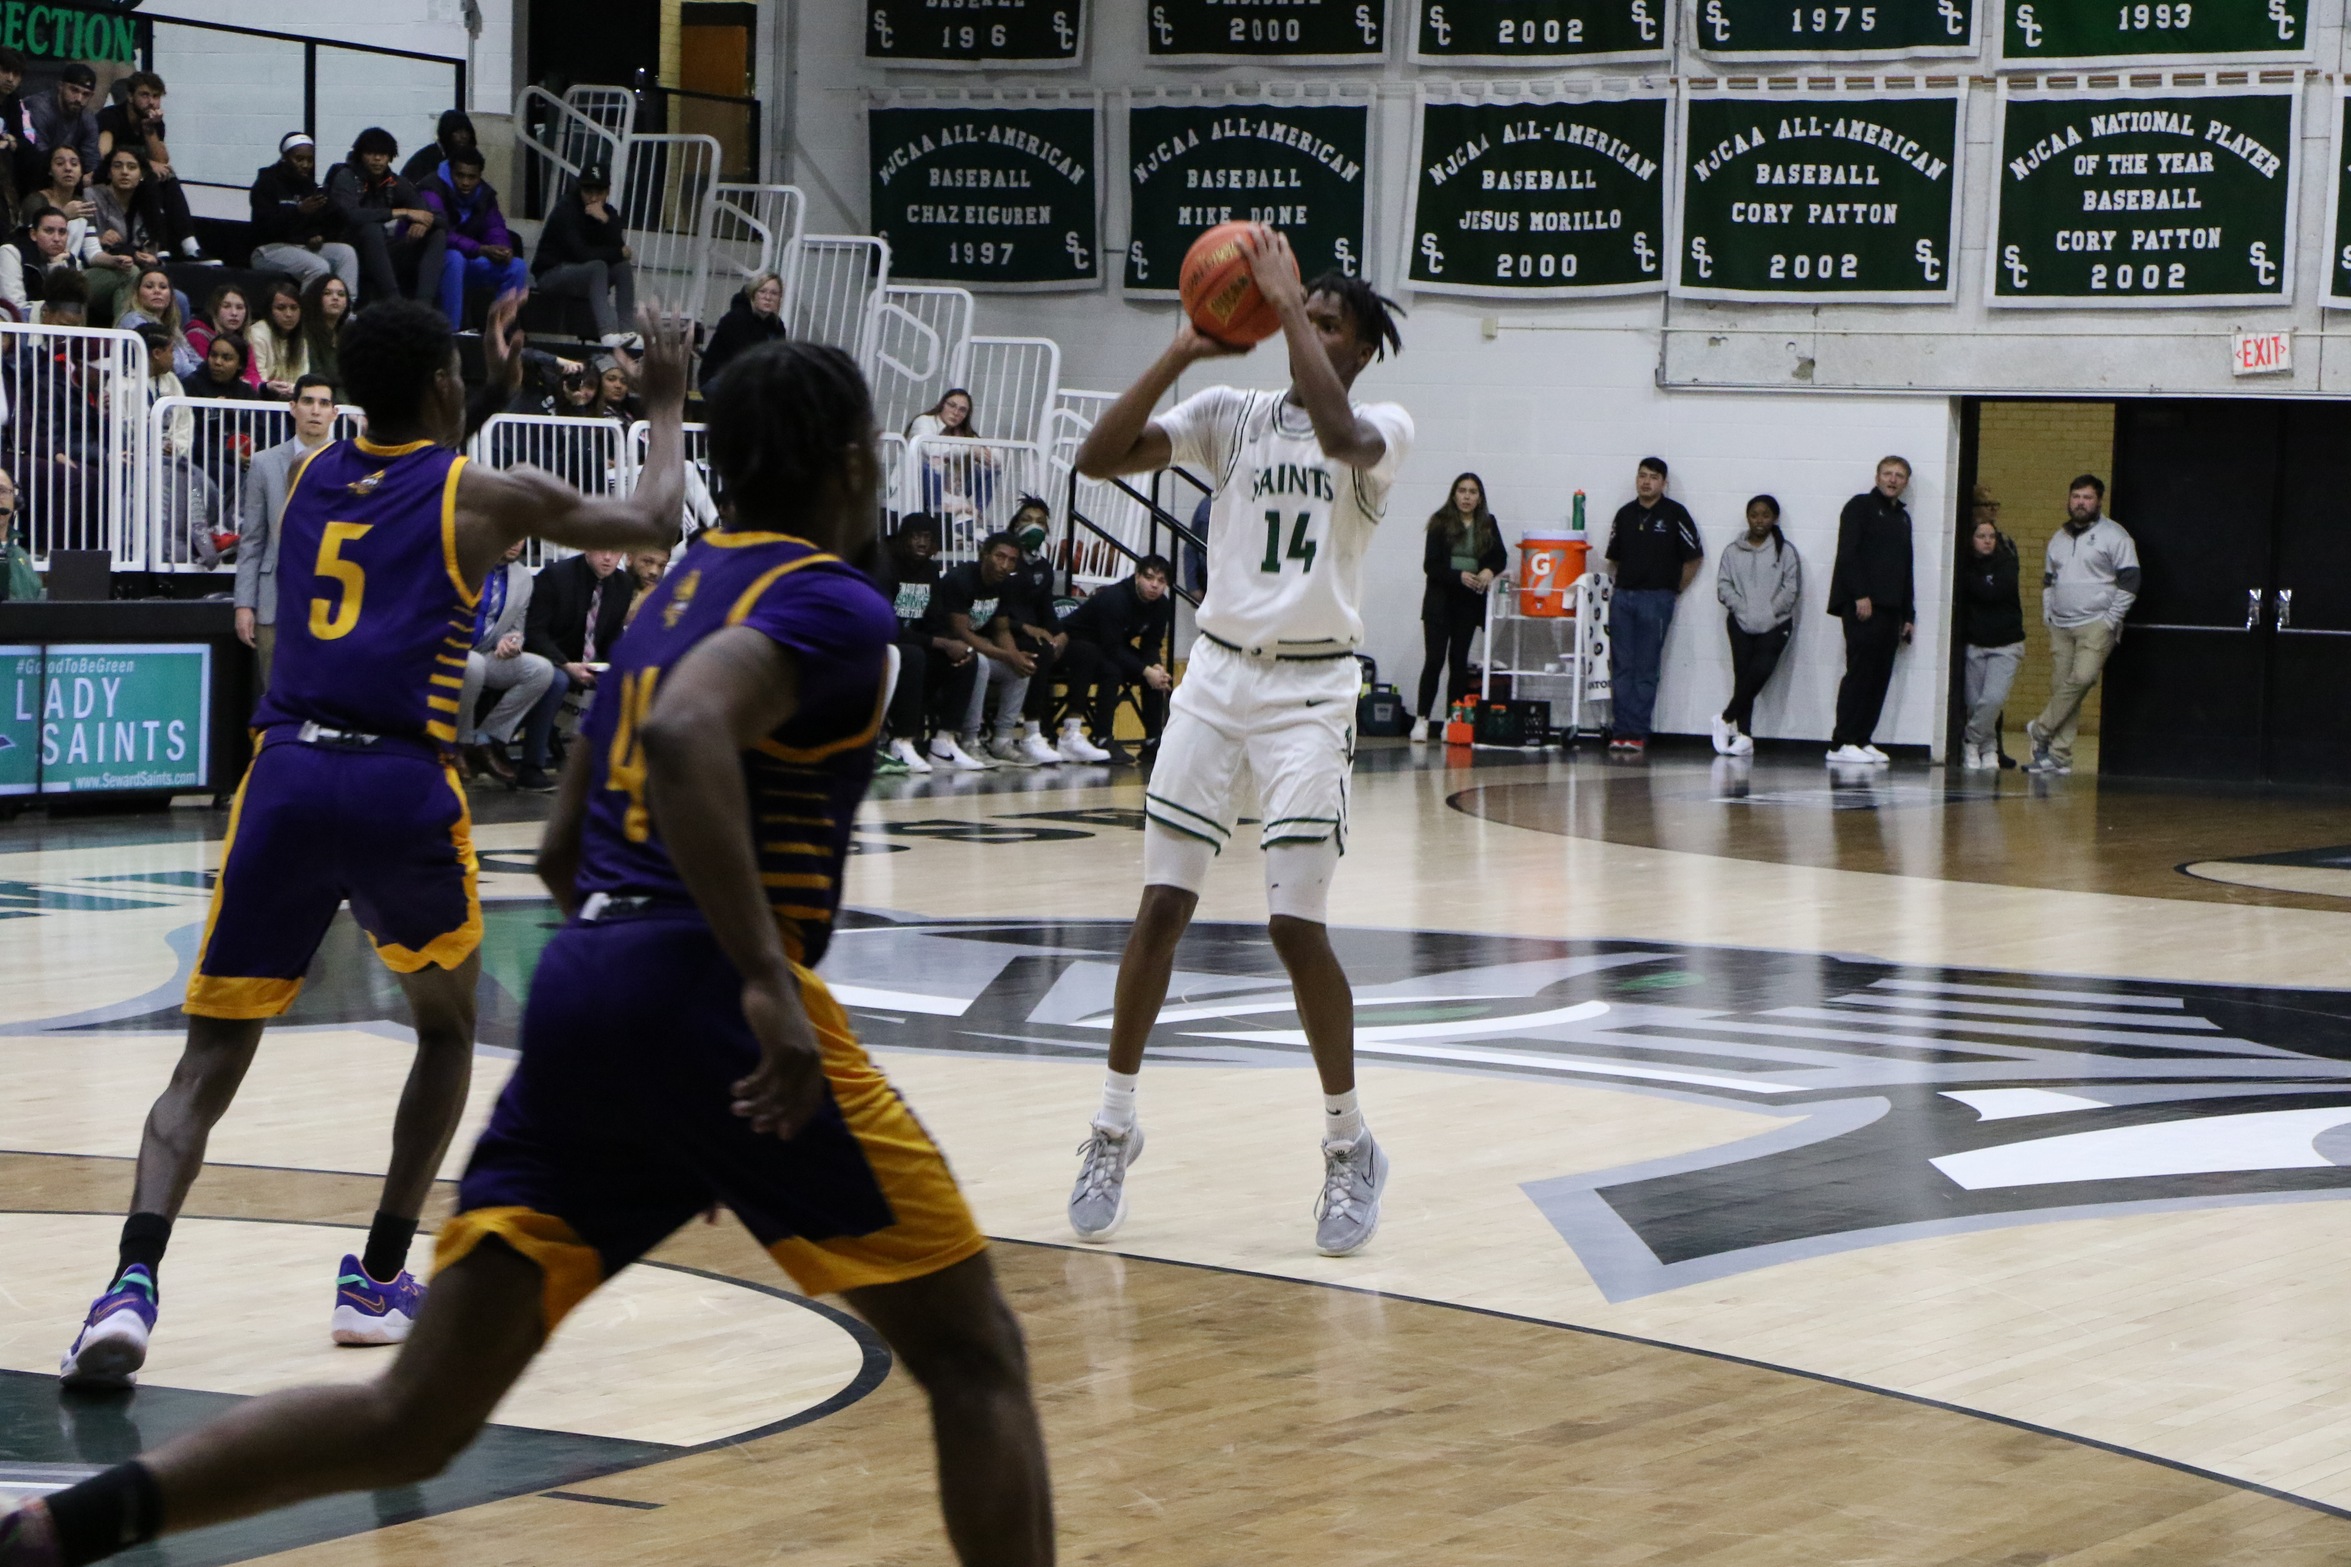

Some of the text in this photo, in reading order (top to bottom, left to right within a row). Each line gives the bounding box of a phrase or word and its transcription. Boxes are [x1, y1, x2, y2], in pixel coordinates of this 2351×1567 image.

[1230, 17, 1299, 41] 2000
[1792, 7, 1875, 32] 1975
[2119, 3, 2192, 30] 1993
[0, 1, 136, 64] ECTION
[1499, 19, 1583, 43] 2002
[879, 124, 1085, 186] NJCAA ALL-AMERICAN
[1133, 117, 1360, 184] NJCAA ALL-AMERICAN
[1428, 120, 1657, 186] NJCAA ALL-AMERICAN
[1693, 116, 1948, 182] NJCAA ALL-AMERICAN
[2009, 110, 2281, 181] NJCAA NATIONAL PLAYER
[1756, 163, 1880, 185] BASEBALL
[2074, 152, 2215, 176] OF THE YEAR
[929, 168, 1031, 187] BASEBALL
[1187, 169, 1302, 188] BASEBALL
[1482, 169, 1597, 190] BASEBALL
[2083, 188, 2202, 211] BASEBALL
[906, 204, 1051, 225] CHAZ EIGUREN
[1178, 206, 1232, 225] MIKE
[1459, 209, 1622, 232] JESUS MORILLO
[1732, 202, 1898, 225] CORY PATTON
[2056, 227, 2222, 251] CORY PATTON
[950, 242, 1014, 265] 1997
[1497, 253, 1577, 278] 2000
[1770, 253, 1858, 279] 2002
[2091, 263, 2186, 289] 2002
[2243, 336, 2280, 367] EXIT
[1261, 509, 1317, 574] 14
[308, 521, 374, 641] 5
[15, 677, 121, 721] LADY
[42, 720, 187, 766] SAINTS
[75, 771, 196, 790] www.SewardSaints.com
